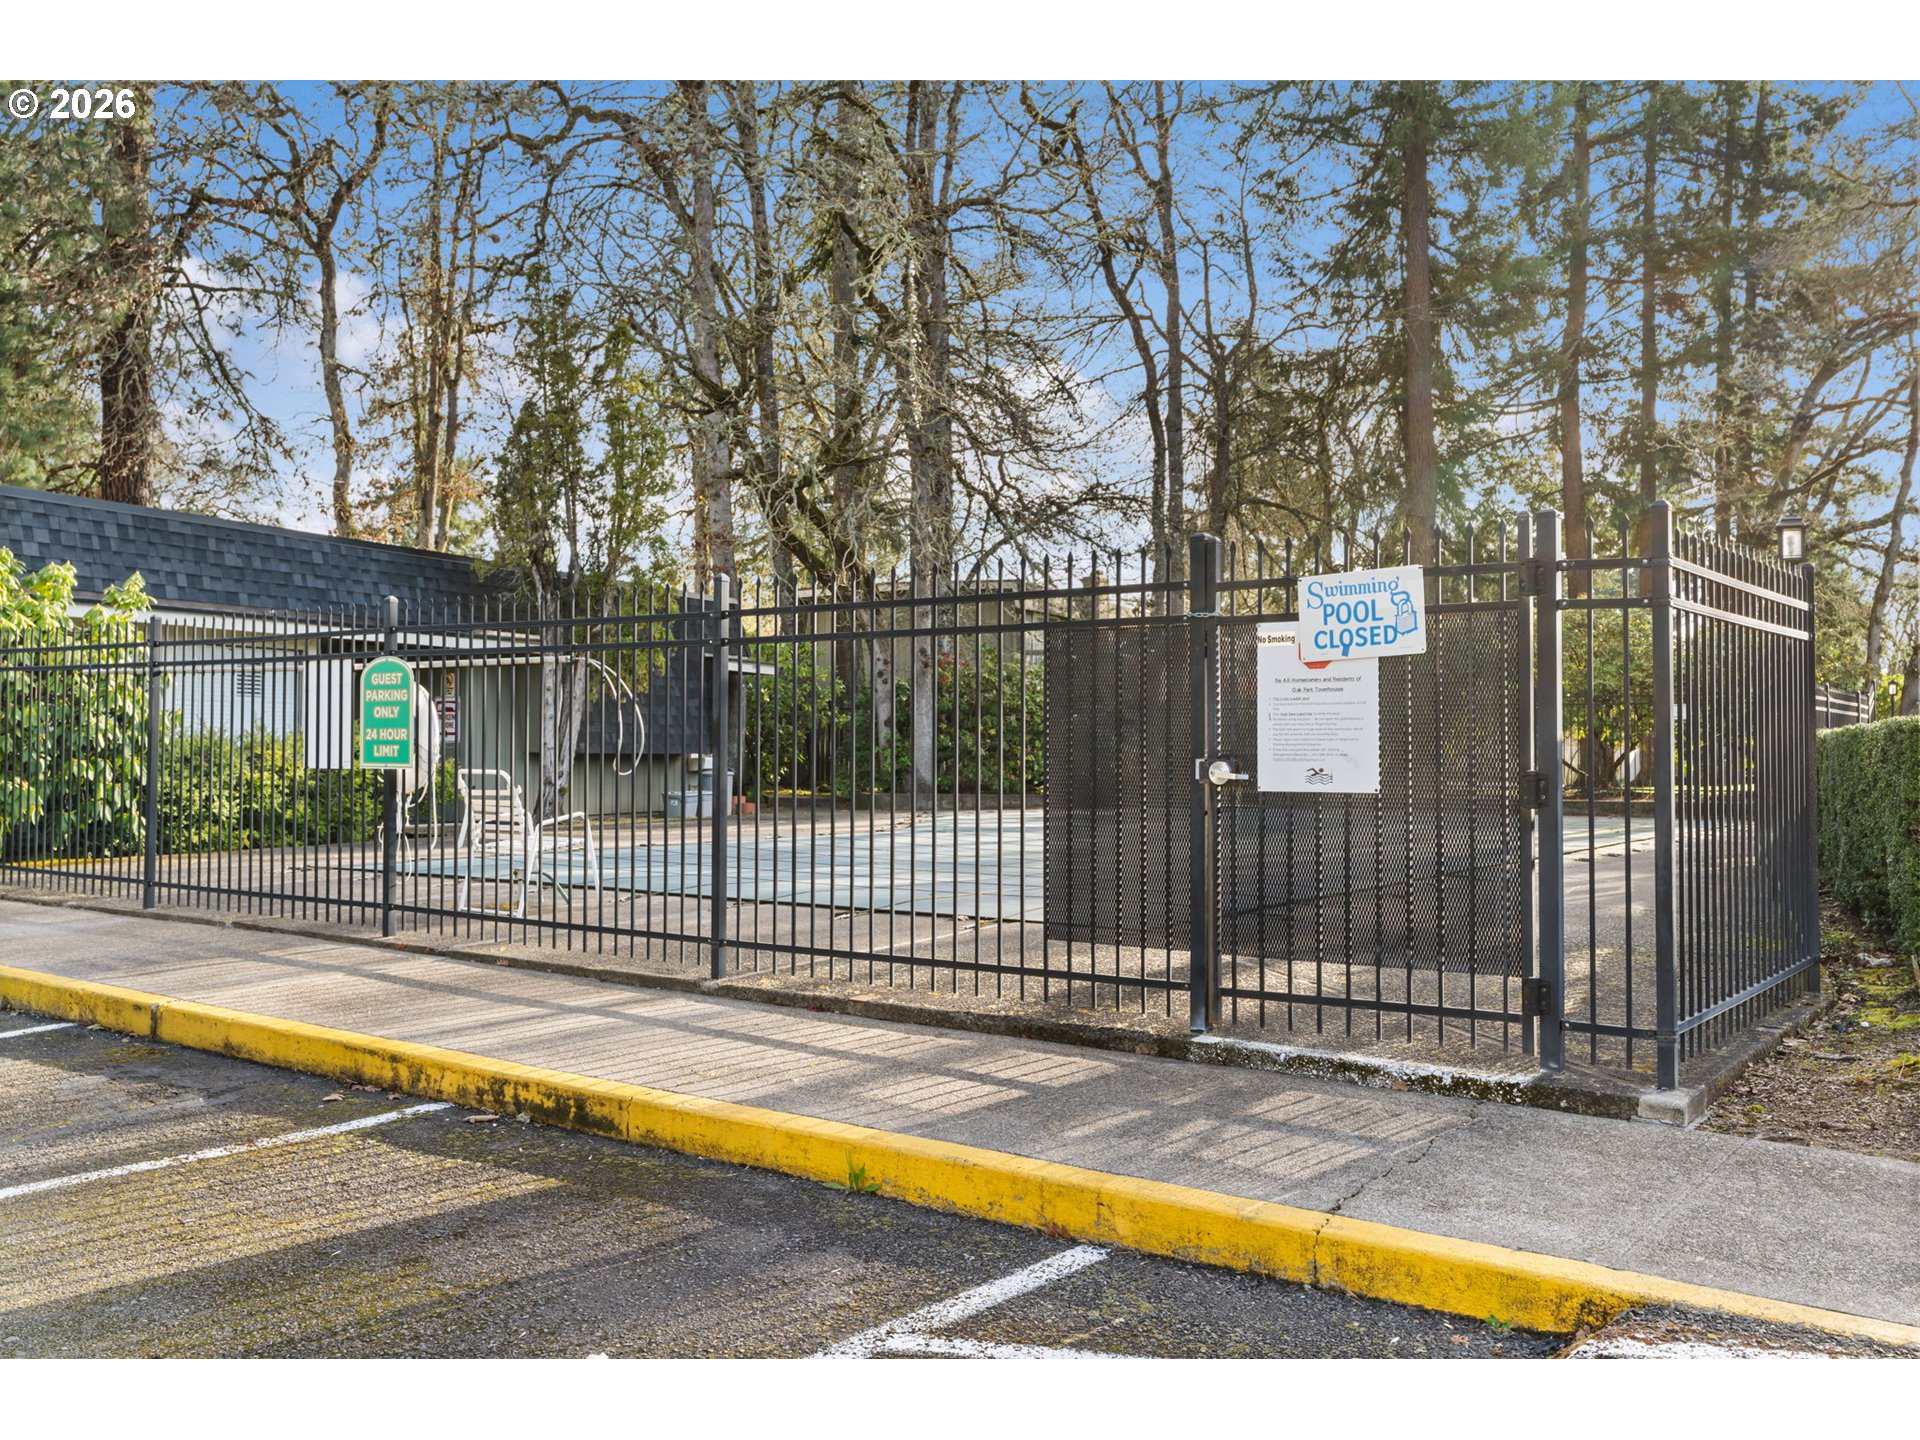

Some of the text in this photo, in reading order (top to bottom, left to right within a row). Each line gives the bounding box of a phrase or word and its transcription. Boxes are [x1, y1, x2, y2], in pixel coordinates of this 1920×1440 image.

[1307, 576, 1401, 609] Swimming
[1323, 599, 1384, 626] POOL
[1267, 634, 1296, 644] Smoking
[1314, 625, 1398, 651] CLOSED
[371, 672, 403, 685] GUEST
[365, 689, 408, 701] PARKING
[373, 706, 400, 718] ONLY
[365, 728, 407, 740] 24 HOUR
[373, 744, 400, 757] LIMIT
